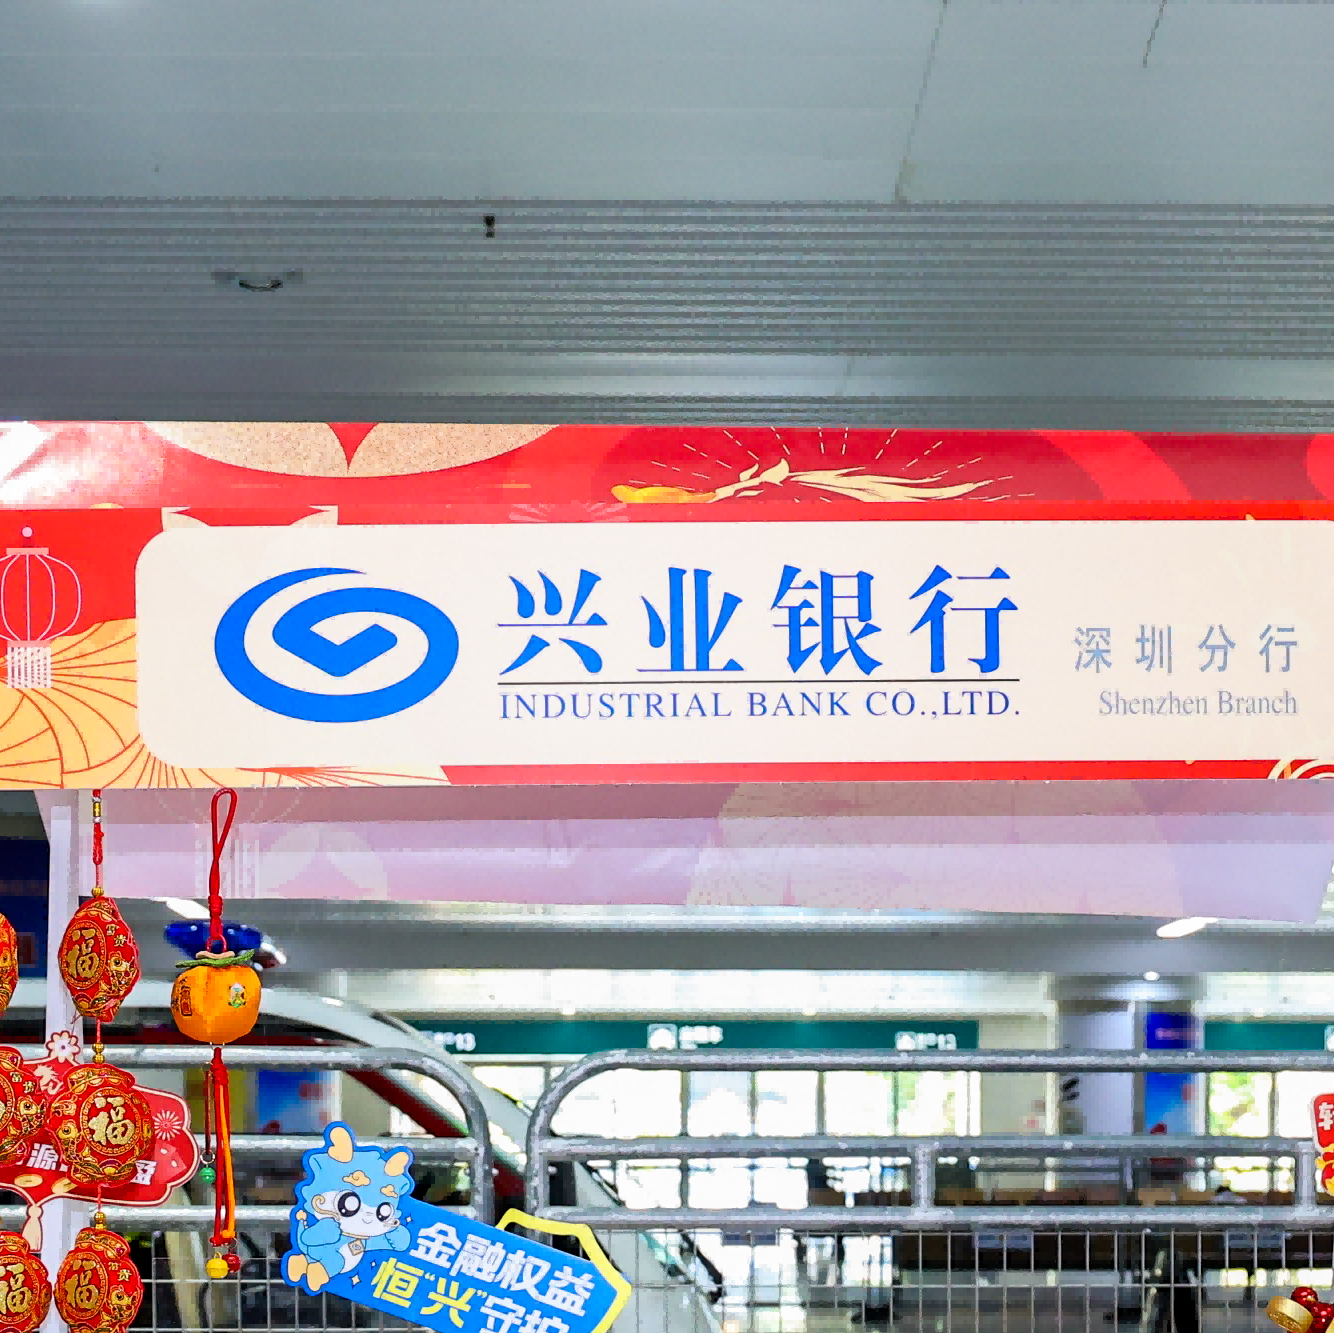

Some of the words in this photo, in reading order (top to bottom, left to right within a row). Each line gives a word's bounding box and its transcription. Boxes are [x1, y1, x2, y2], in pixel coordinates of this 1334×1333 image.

[498, 563, 1019, 678] 兴业银行
[1073, 623, 1300, 676] 深圳分行
[499, 692, 733, 720] INDUSTRIAL
[747, 692, 852, 718] BANK
[865, 690, 1021, 720] CO.,LTD.
[1098, 688, 1210, 716] Shenzhen
[1217, 688, 1299, 716] Branch
[66, 928, 100, 979] 福
[88, 1096, 136, 1146] 福
[64, 1259, 99, 1309] 福
[409, 1221, 596, 1318] 金融权益
